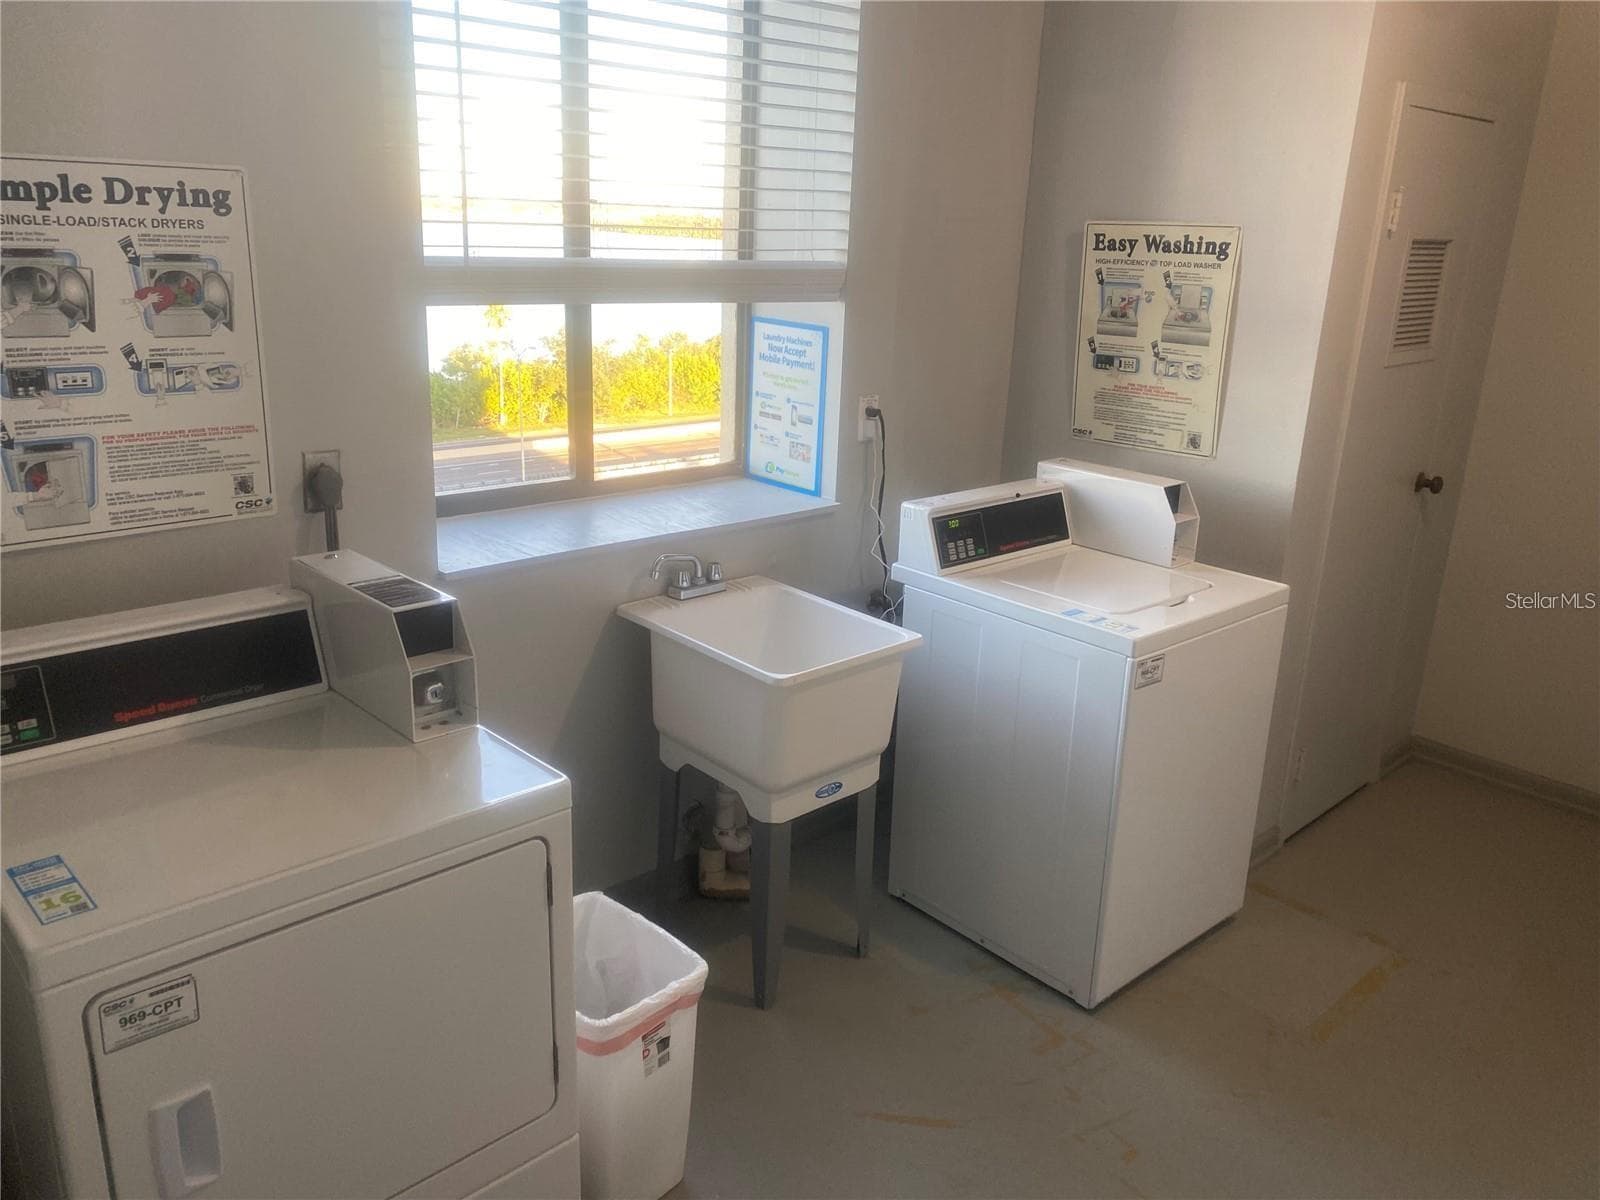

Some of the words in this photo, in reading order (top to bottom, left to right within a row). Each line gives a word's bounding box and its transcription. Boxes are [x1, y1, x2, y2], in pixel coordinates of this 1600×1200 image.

[101, 176, 233, 218] Drying
[0, 213, 148, 229] SINGLE-LOAD/STACK
[151, 217, 205, 231] DRYERS
[127, 247, 136, 258] 2
[1093, 233, 1139, 258] Easy
[1143, 234, 1232, 262] Washing
[1095, 258, 1149, 267] HIGH-EFFICIENCY
[1193, 262, 1222, 270] WASHER
[128, 354, 137, 363] 4
[759, 352, 781, 364] Mobile
[768, 343, 783, 353] Now
[784, 345, 807, 359] Accept
[235, 499, 263, 510] CSC
[112, 703, 156, 722] Speed
[38, 890, 82, 912] 16
[118, 995, 184, 1028] 969-CPT
